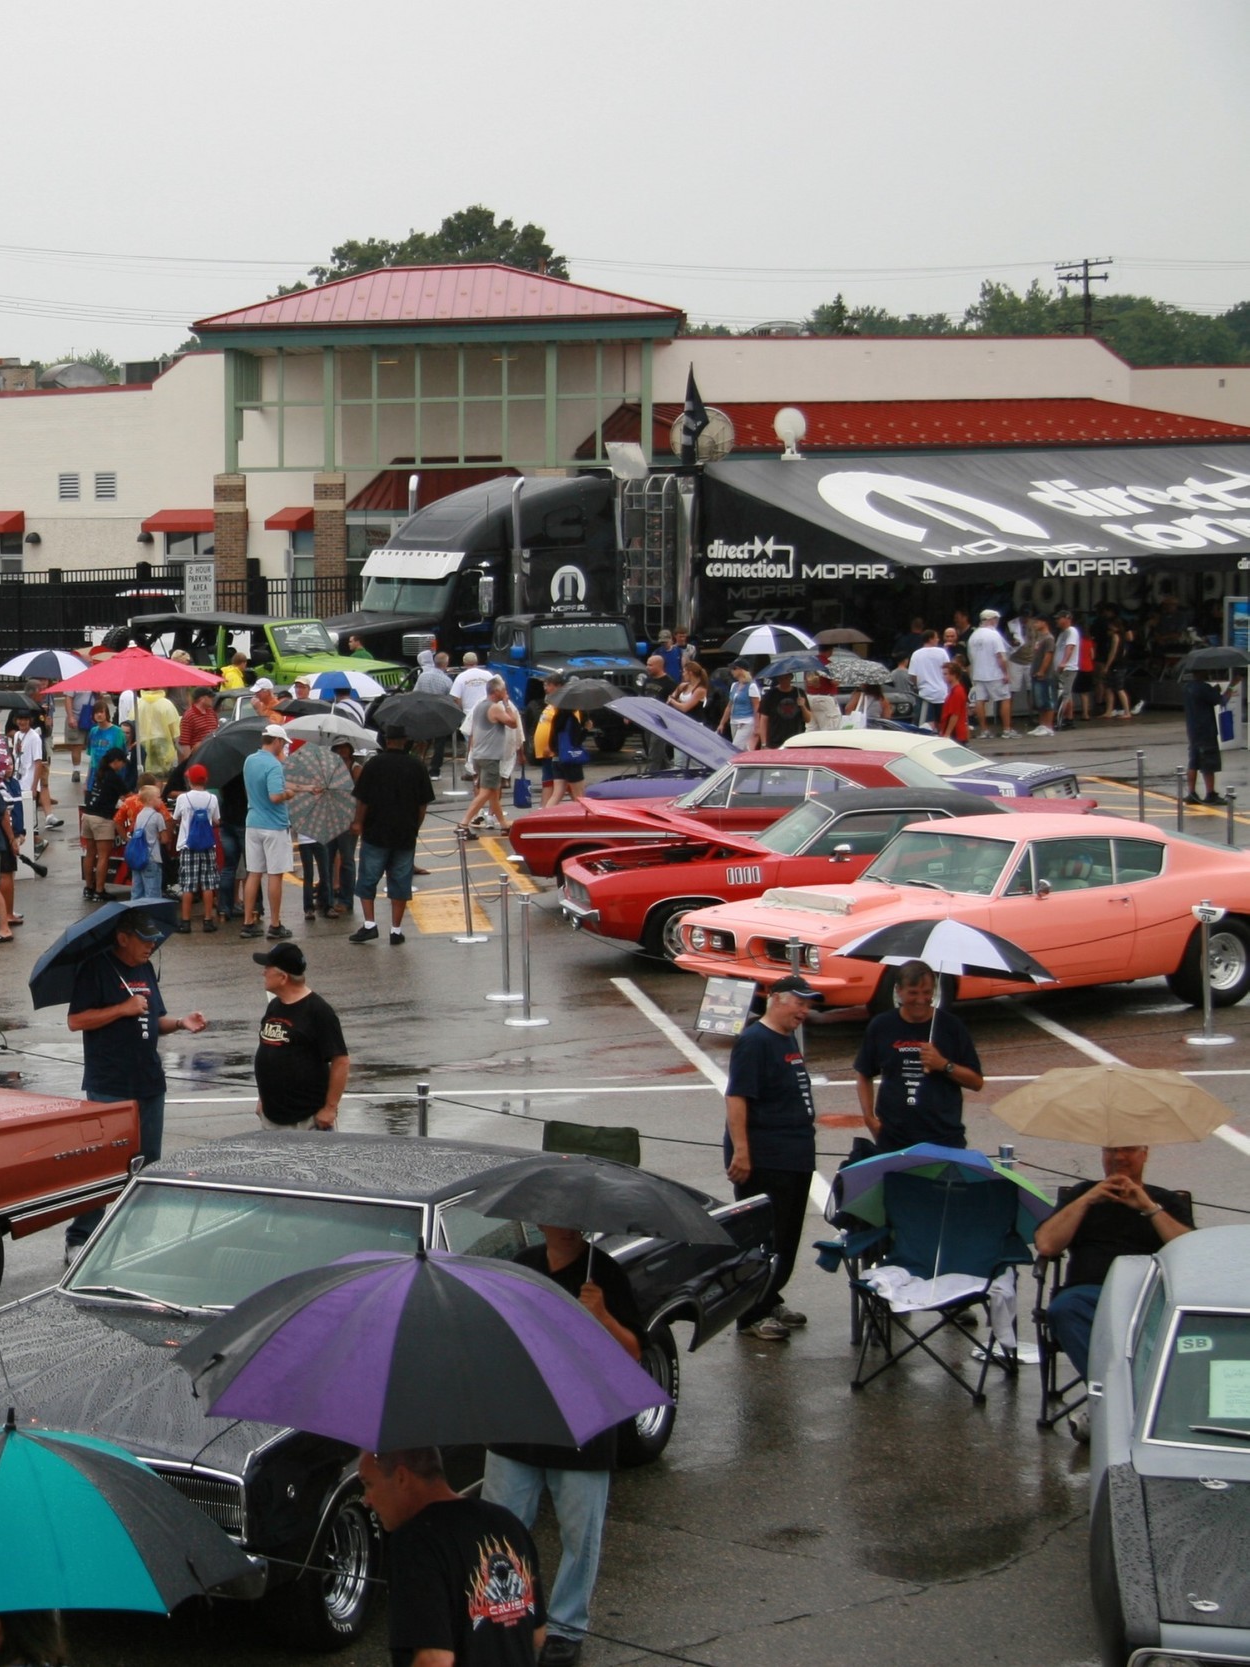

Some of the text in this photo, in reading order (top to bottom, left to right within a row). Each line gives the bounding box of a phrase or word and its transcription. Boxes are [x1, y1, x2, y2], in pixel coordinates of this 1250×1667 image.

[707, 539, 750, 559] direct
[705, 558, 787, 579] connection
[801, 563, 888, 580] MOPAR
[1043, 558, 1131, 578] MOPAR
[188, 574, 212, 583] PARKING
[193, 583, 207, 591] AREA
[727, 584, 806, 601] MOPAR
[726, 607, 805, 624] SRT
[1182, 1338, 1208, 1350] SB
